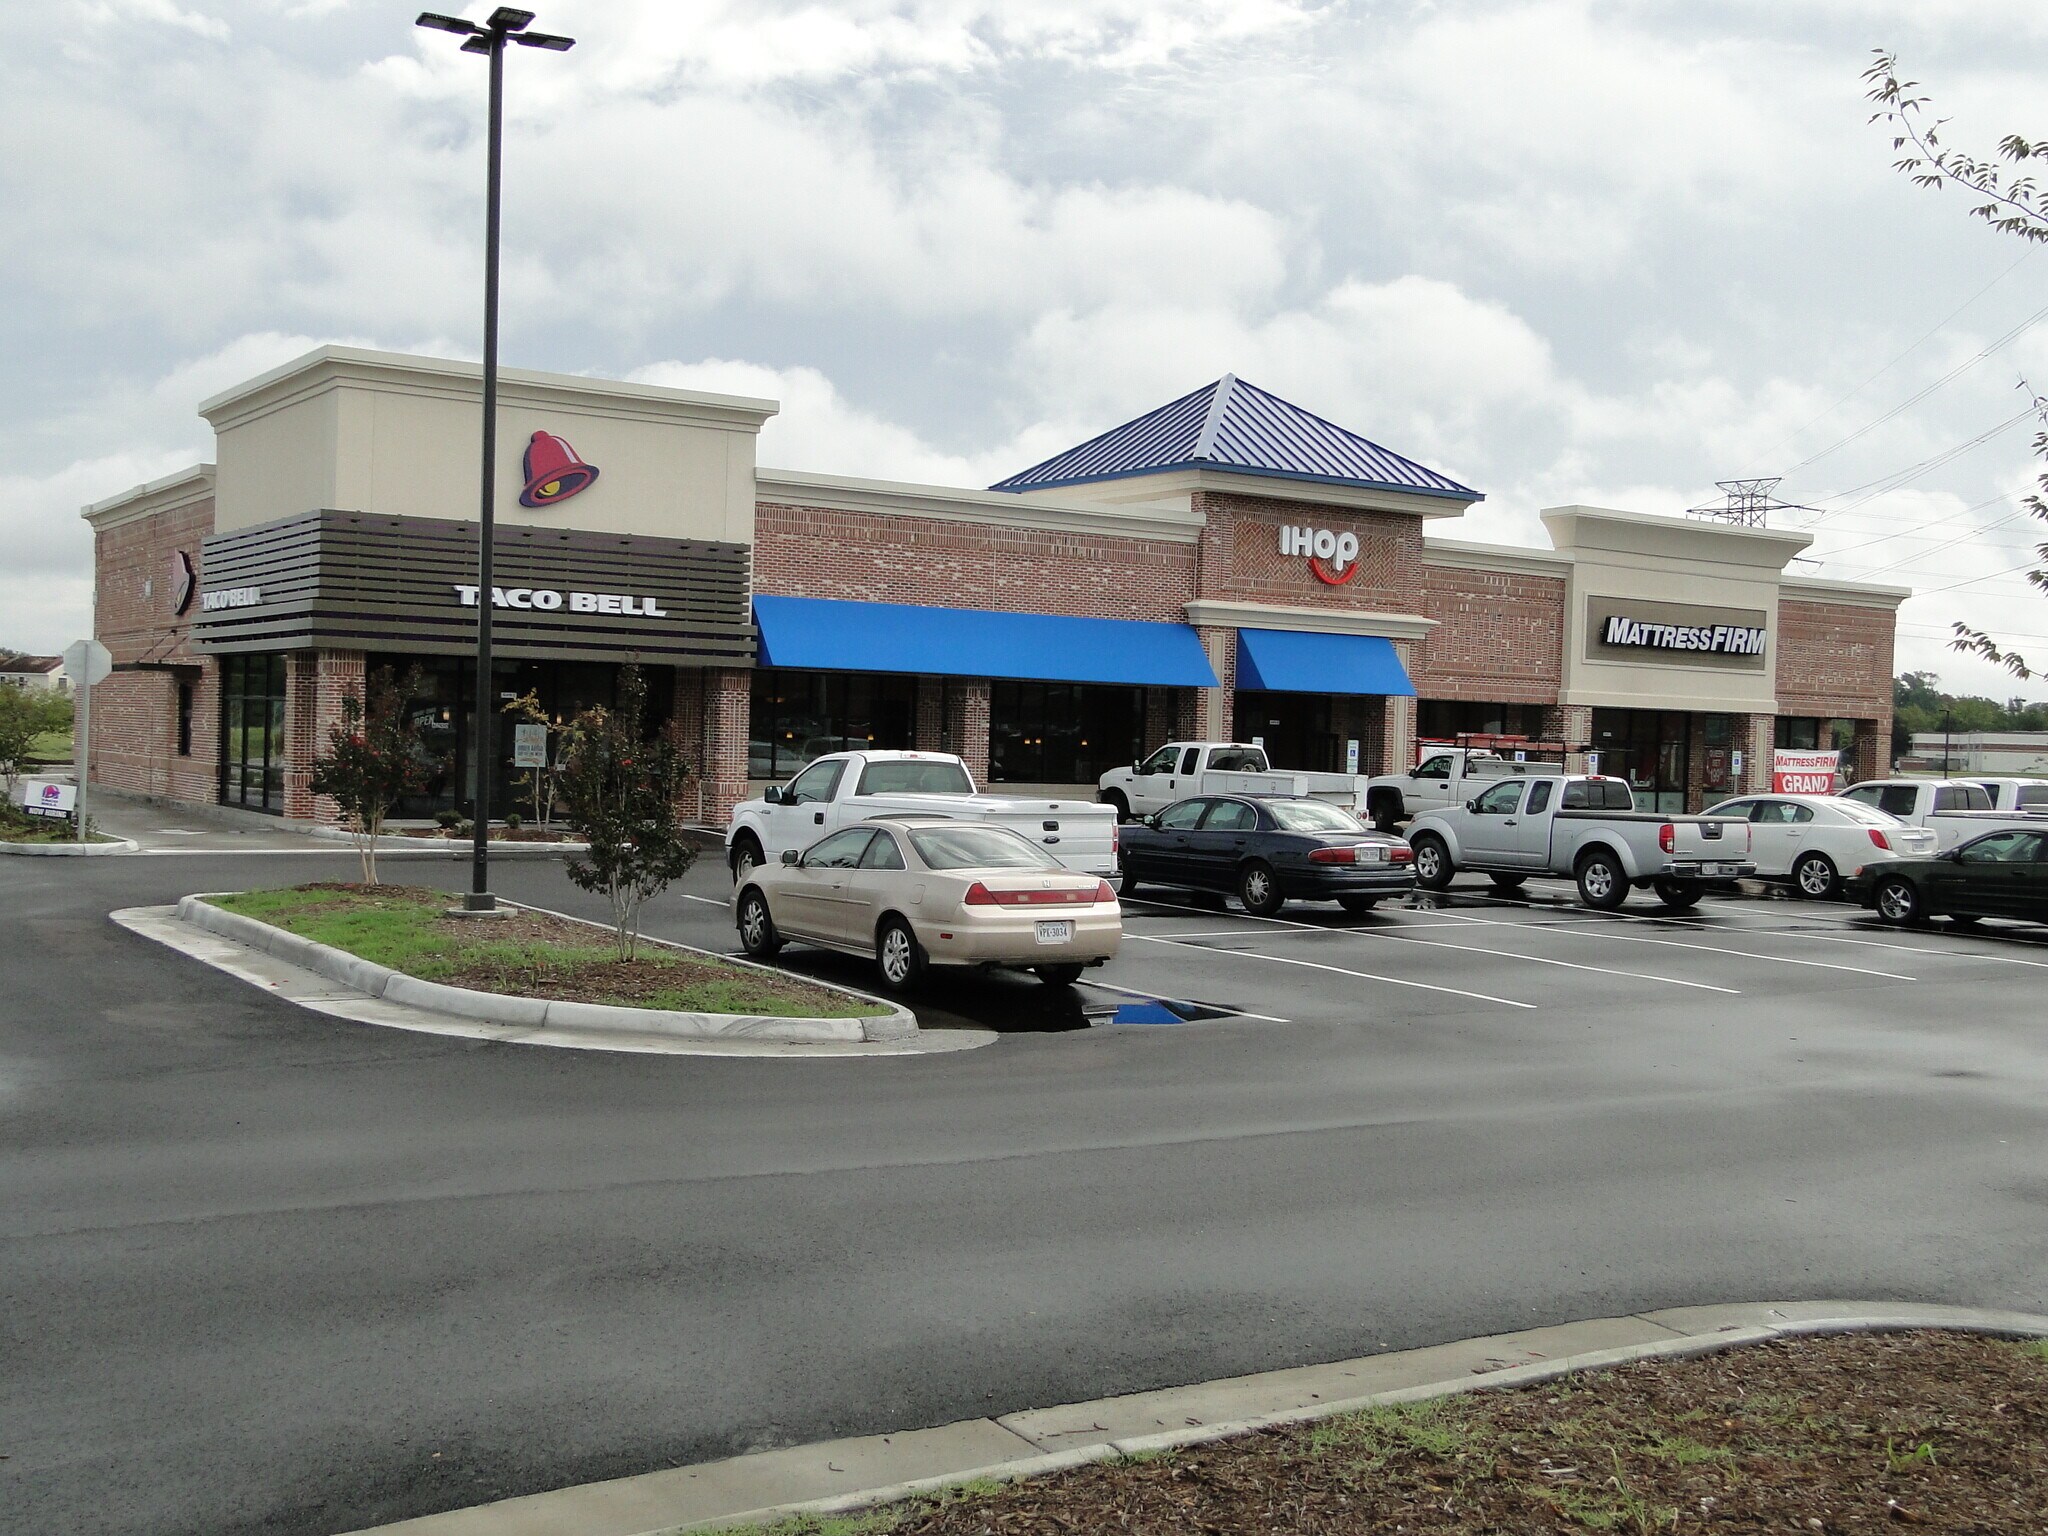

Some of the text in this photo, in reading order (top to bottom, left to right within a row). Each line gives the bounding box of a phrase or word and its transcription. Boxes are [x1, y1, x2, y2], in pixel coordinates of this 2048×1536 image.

[202, 587, 262, 610] TACO BELL
[453, 585, 667, 617] TACO BELL
[1782, 774, 1829, 793] GRAND
